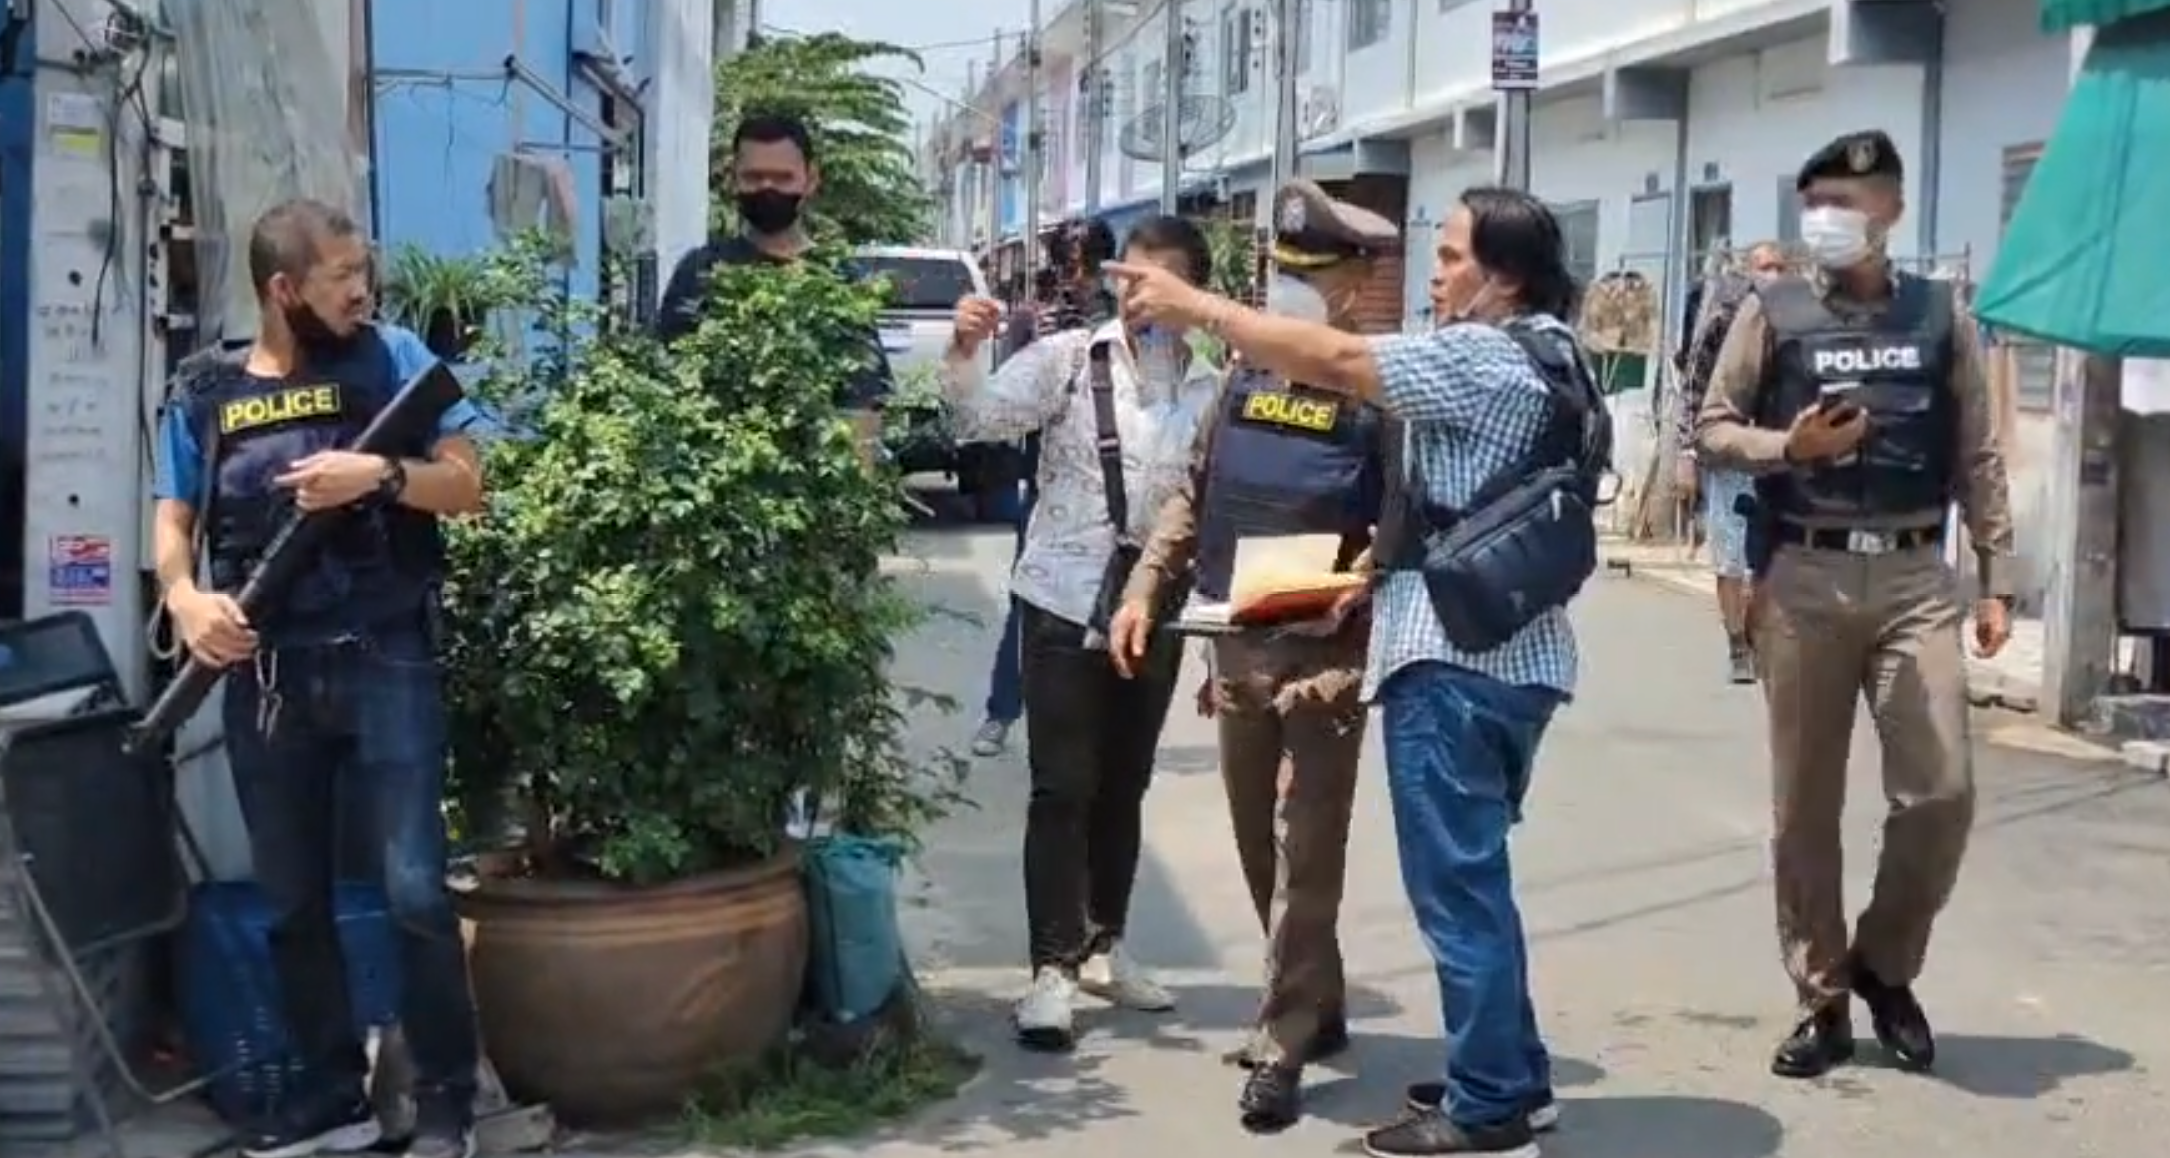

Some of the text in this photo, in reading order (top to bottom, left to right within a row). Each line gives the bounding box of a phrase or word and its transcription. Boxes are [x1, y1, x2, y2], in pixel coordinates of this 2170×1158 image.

[1815, 346, 1921, 373] POLICE
[226, 387, 333, 429] POLICE
[1251, 395, 1332, 431] POLICE
